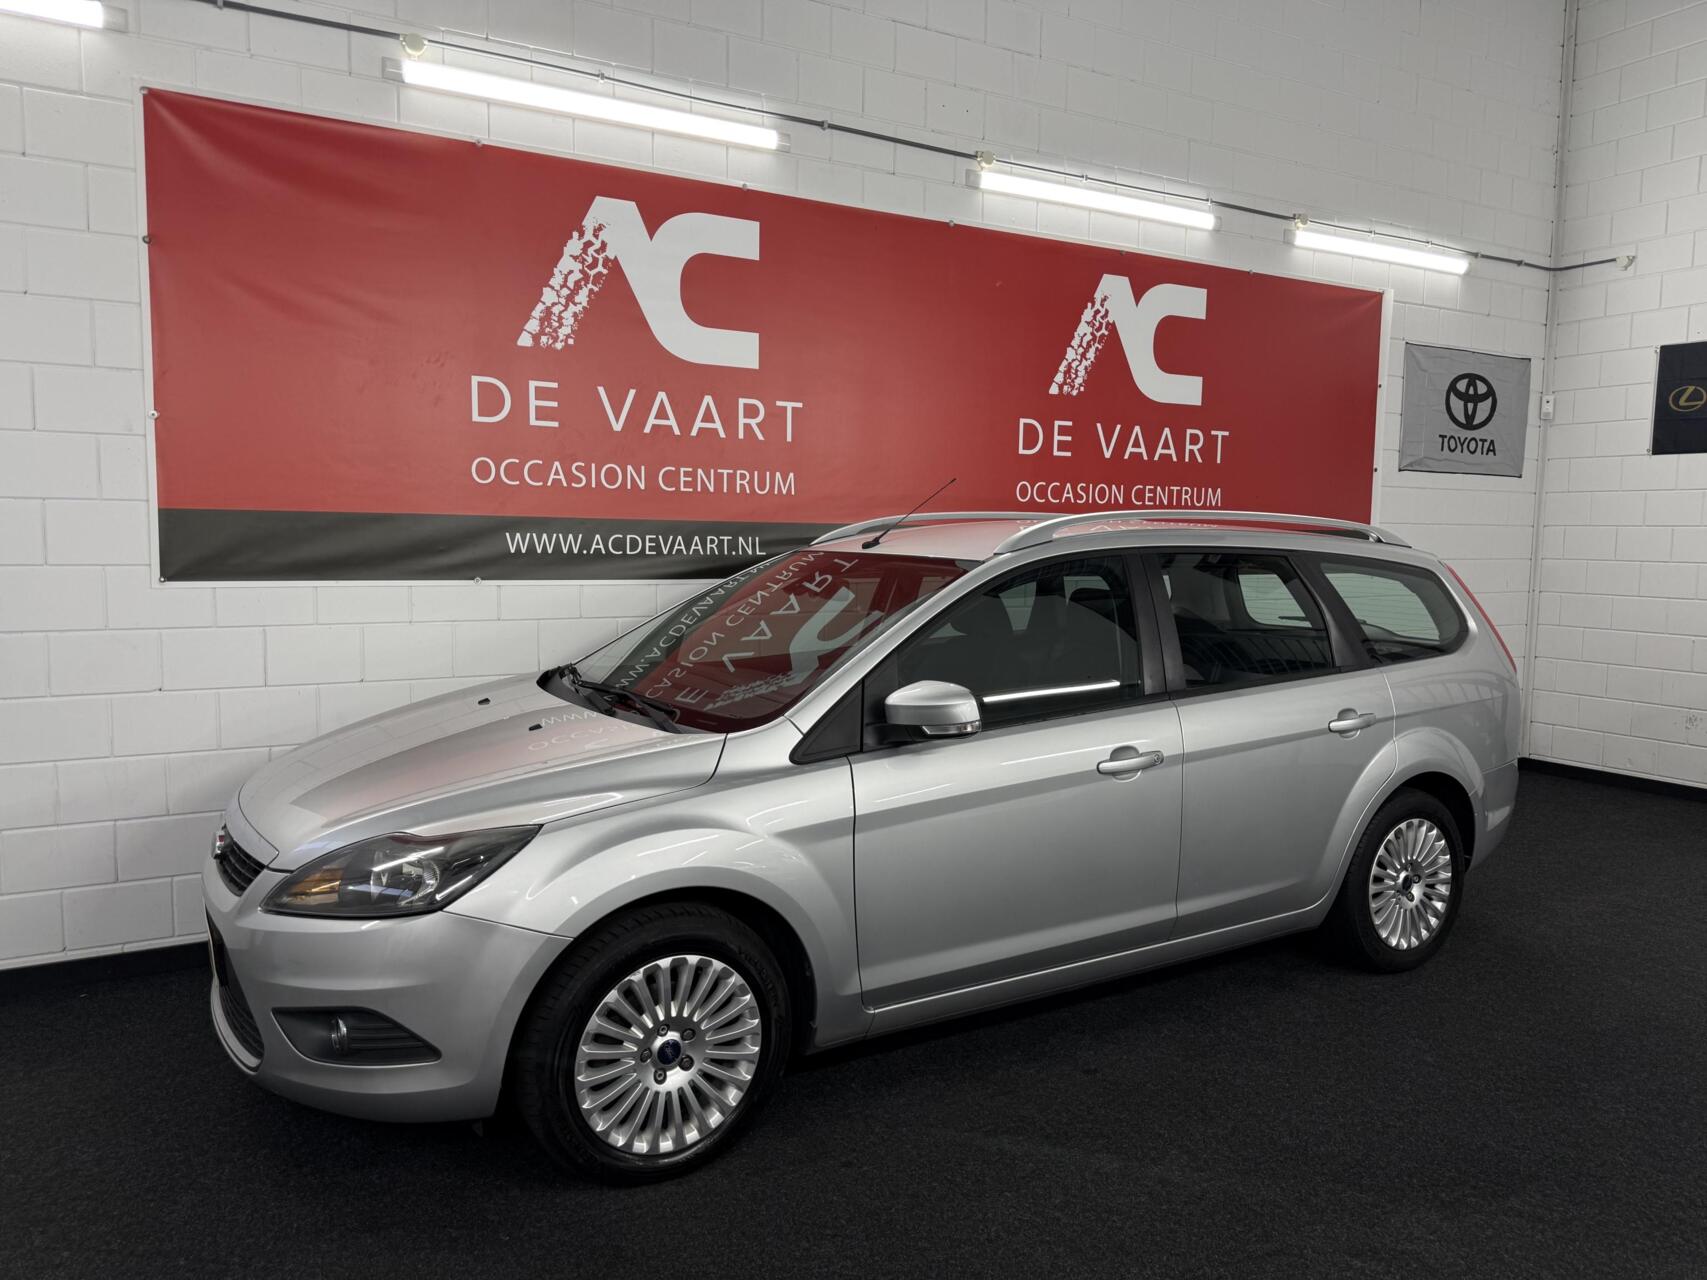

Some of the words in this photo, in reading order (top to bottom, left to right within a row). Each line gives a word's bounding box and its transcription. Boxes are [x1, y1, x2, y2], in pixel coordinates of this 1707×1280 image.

[516, 196, 760, 370] AC
[1048, 273, 1208, 406] AC
[470, 374, 560, 428] DE
[597, 386, 804, 443] VAART
[1018, 417, 1073, 457] DE
[1096, 422, 1230, 465] VAART
[1438, 434, 1497, 457] TOYOTA
[470, 456, 646, 490] OCCASION
[658, 466, 796, 496] CENTRUM
[1015, 480, 1124, 505] OCCASION
[1131, 485, 1222, 507] CENTRUM
[505, 531, 767, 556] WWW.ACDEVAART.NL
